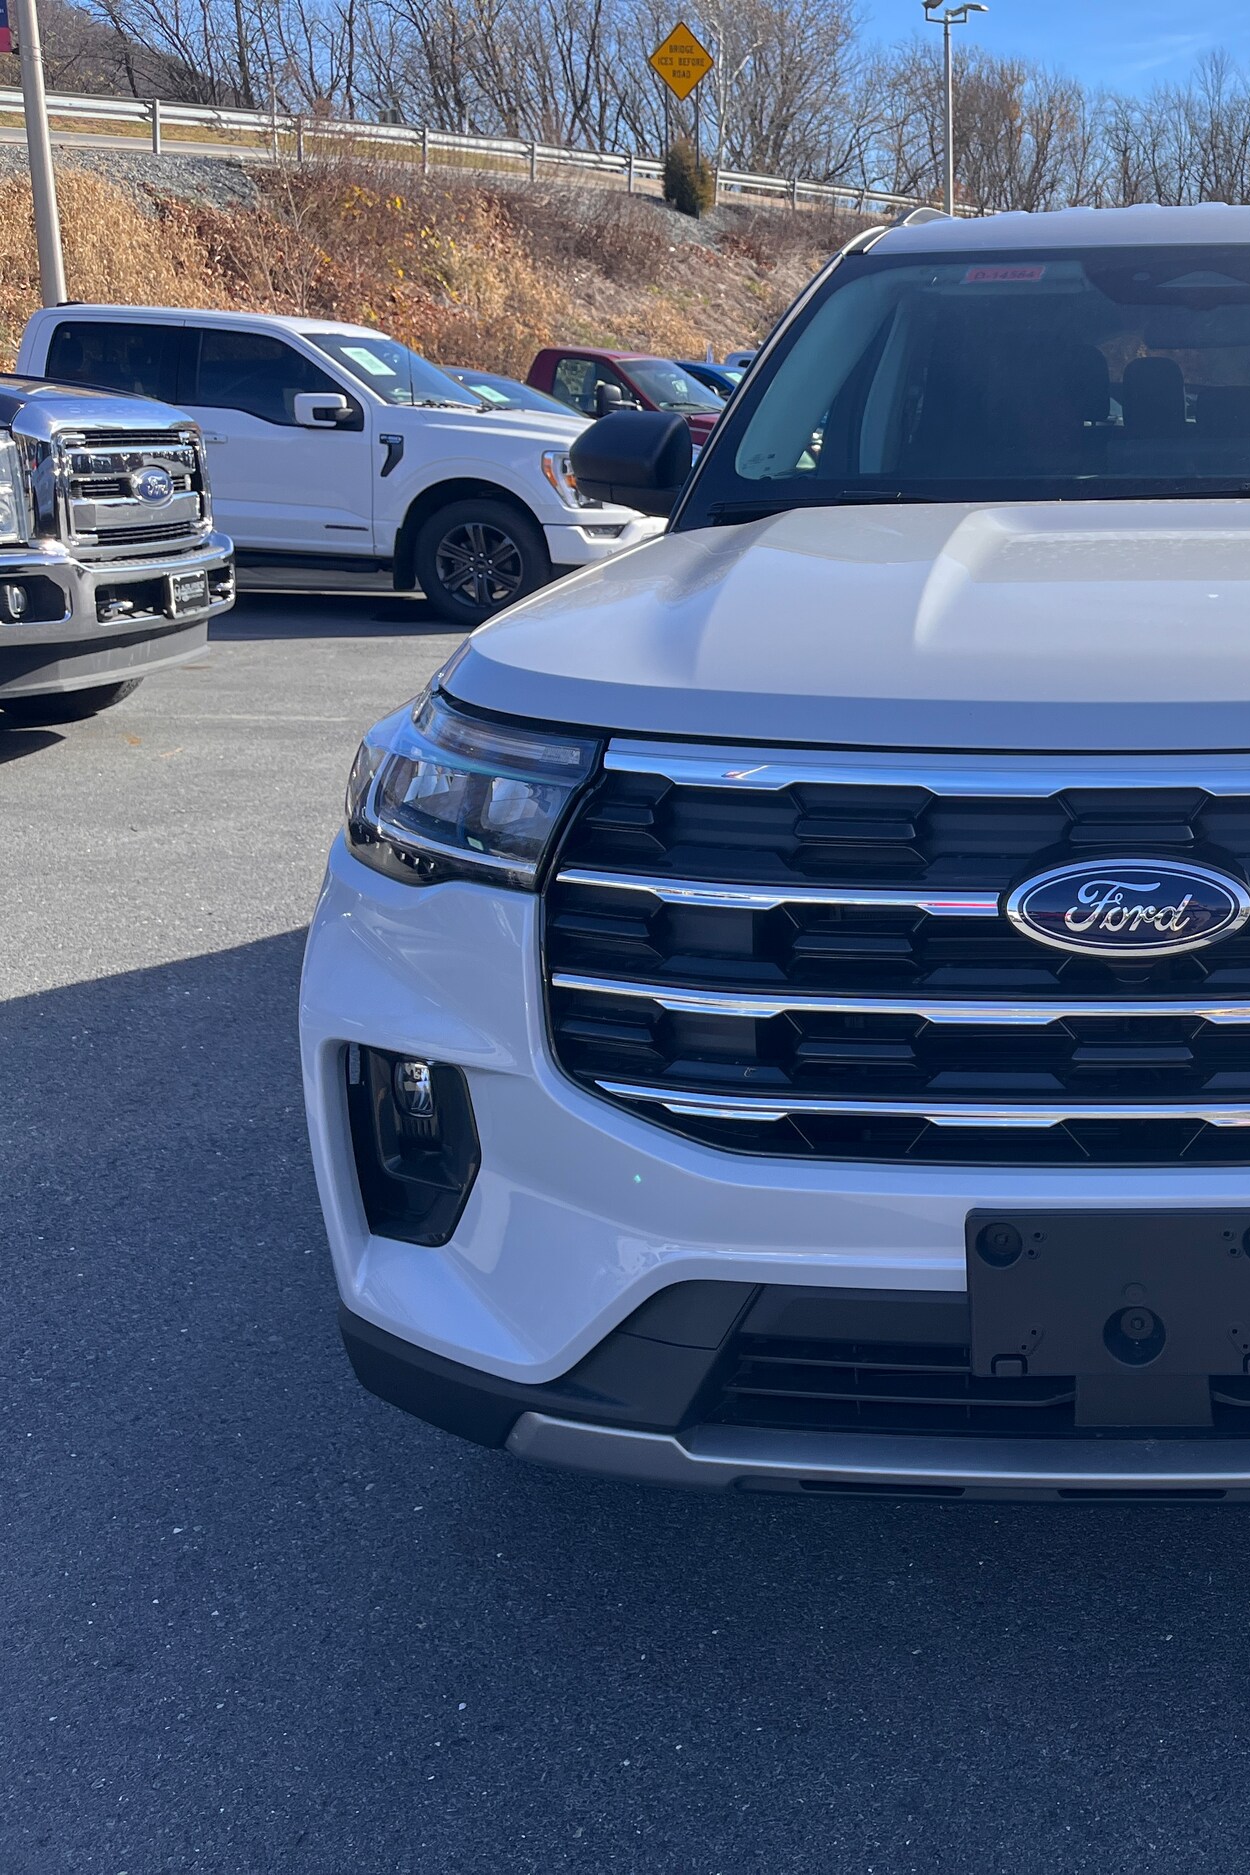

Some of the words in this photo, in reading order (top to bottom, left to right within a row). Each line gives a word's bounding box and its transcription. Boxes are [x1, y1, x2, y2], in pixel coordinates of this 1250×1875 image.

[668, 45, 694, 54] BRIDGE
[658, 57, 674, 66] ICES
[678, 57, 704, 66] BEFORE
[672, 70, 691, 78] ROAD
[1064, 879, 1194, 933] Ford
